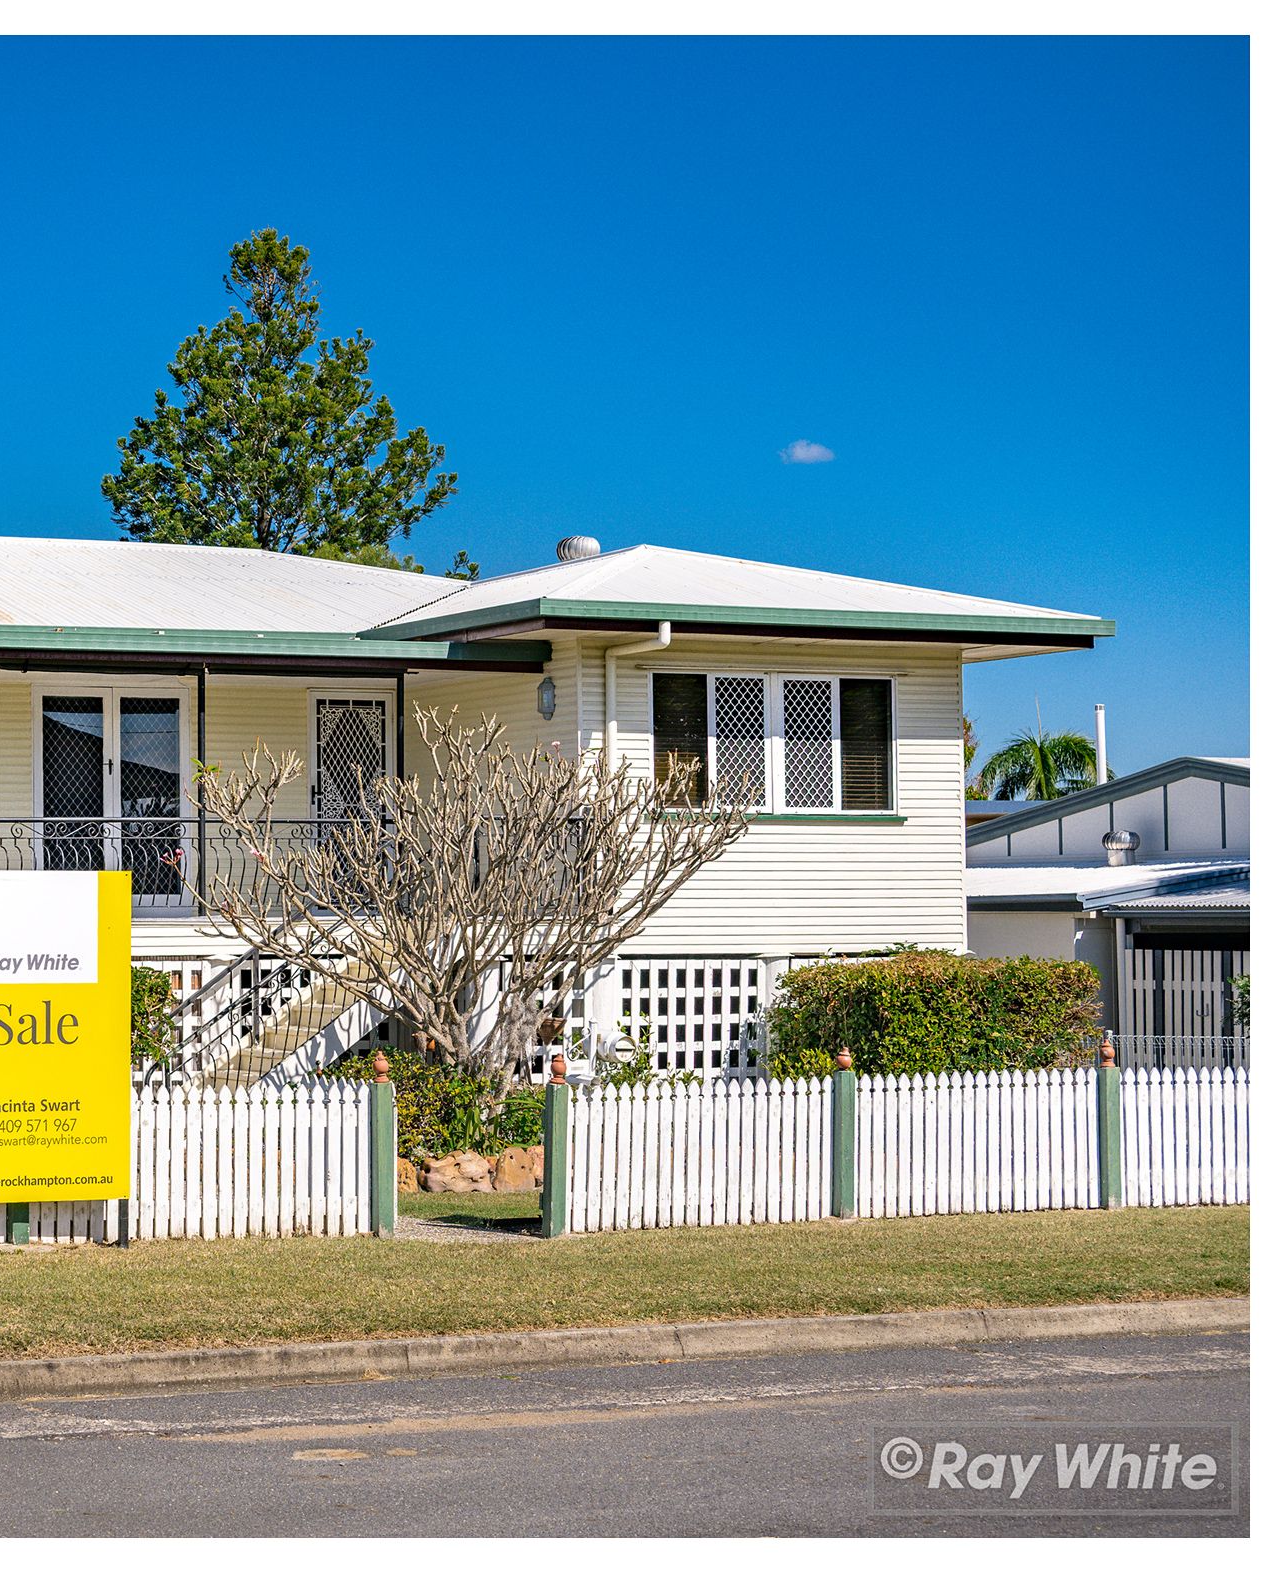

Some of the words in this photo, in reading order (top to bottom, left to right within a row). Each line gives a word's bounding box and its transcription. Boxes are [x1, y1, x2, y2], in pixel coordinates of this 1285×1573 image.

[27, 953, 80, 971] White
[40, 1099, 81, 1112] Swart
[26, 1119, 48, 1132] 571
[53, 1118, 77, 1132] 967
